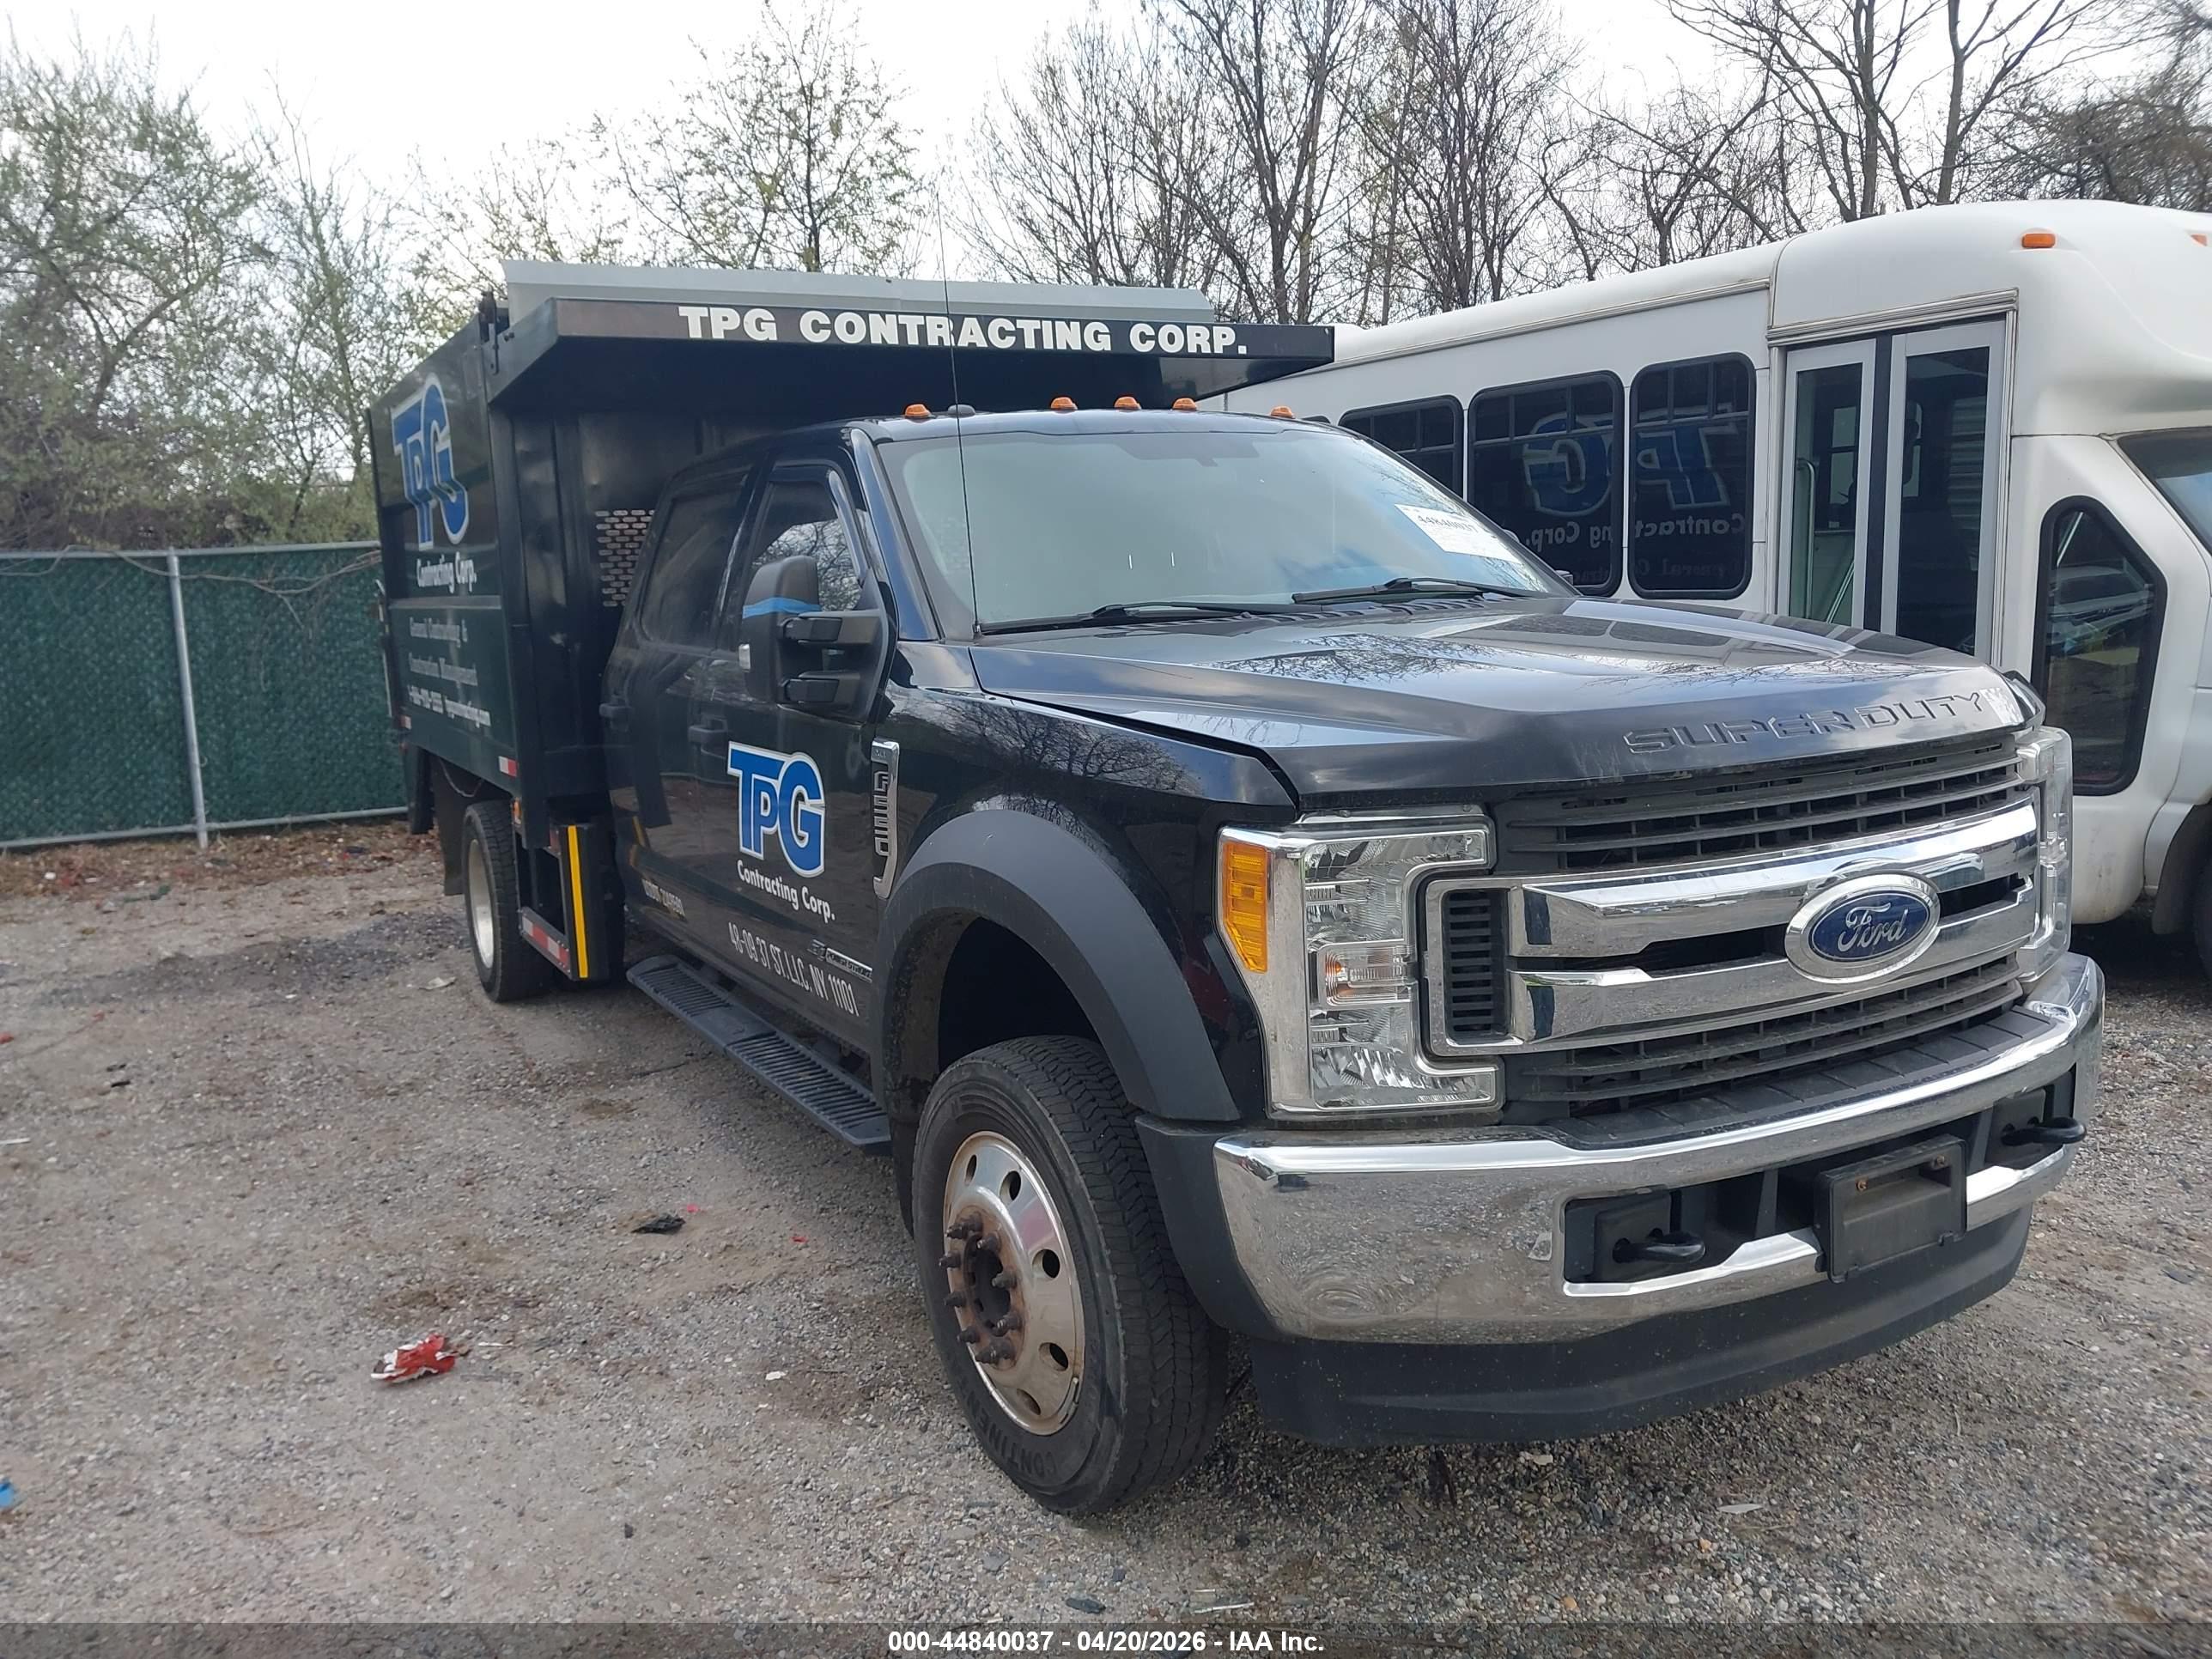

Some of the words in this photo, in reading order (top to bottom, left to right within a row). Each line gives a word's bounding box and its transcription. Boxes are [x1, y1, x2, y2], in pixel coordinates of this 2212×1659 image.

[678, 306, 778, 341] TPG
[799, 310, 1111, 351] CONTRACTING
[1129, 323, 1247, 355] CORP.
[390, 372, 469, 551] TPG
[1624, 710, 1856, 756] SUPER
[1853, 691, 1984, 729] DUTY
[727, 741, 825, 878] TPG
[737, 860, 799, 911] Contracting
[801, 886, 836, 924] Corp.
[1838, 902, 1909, 952] Ford
[728, 922, 759, 963] 48-09
[756, 937, 771, 969] 37
[809, 963, 829, 1001] NY
[828, 973, 860, 1018] 11101
